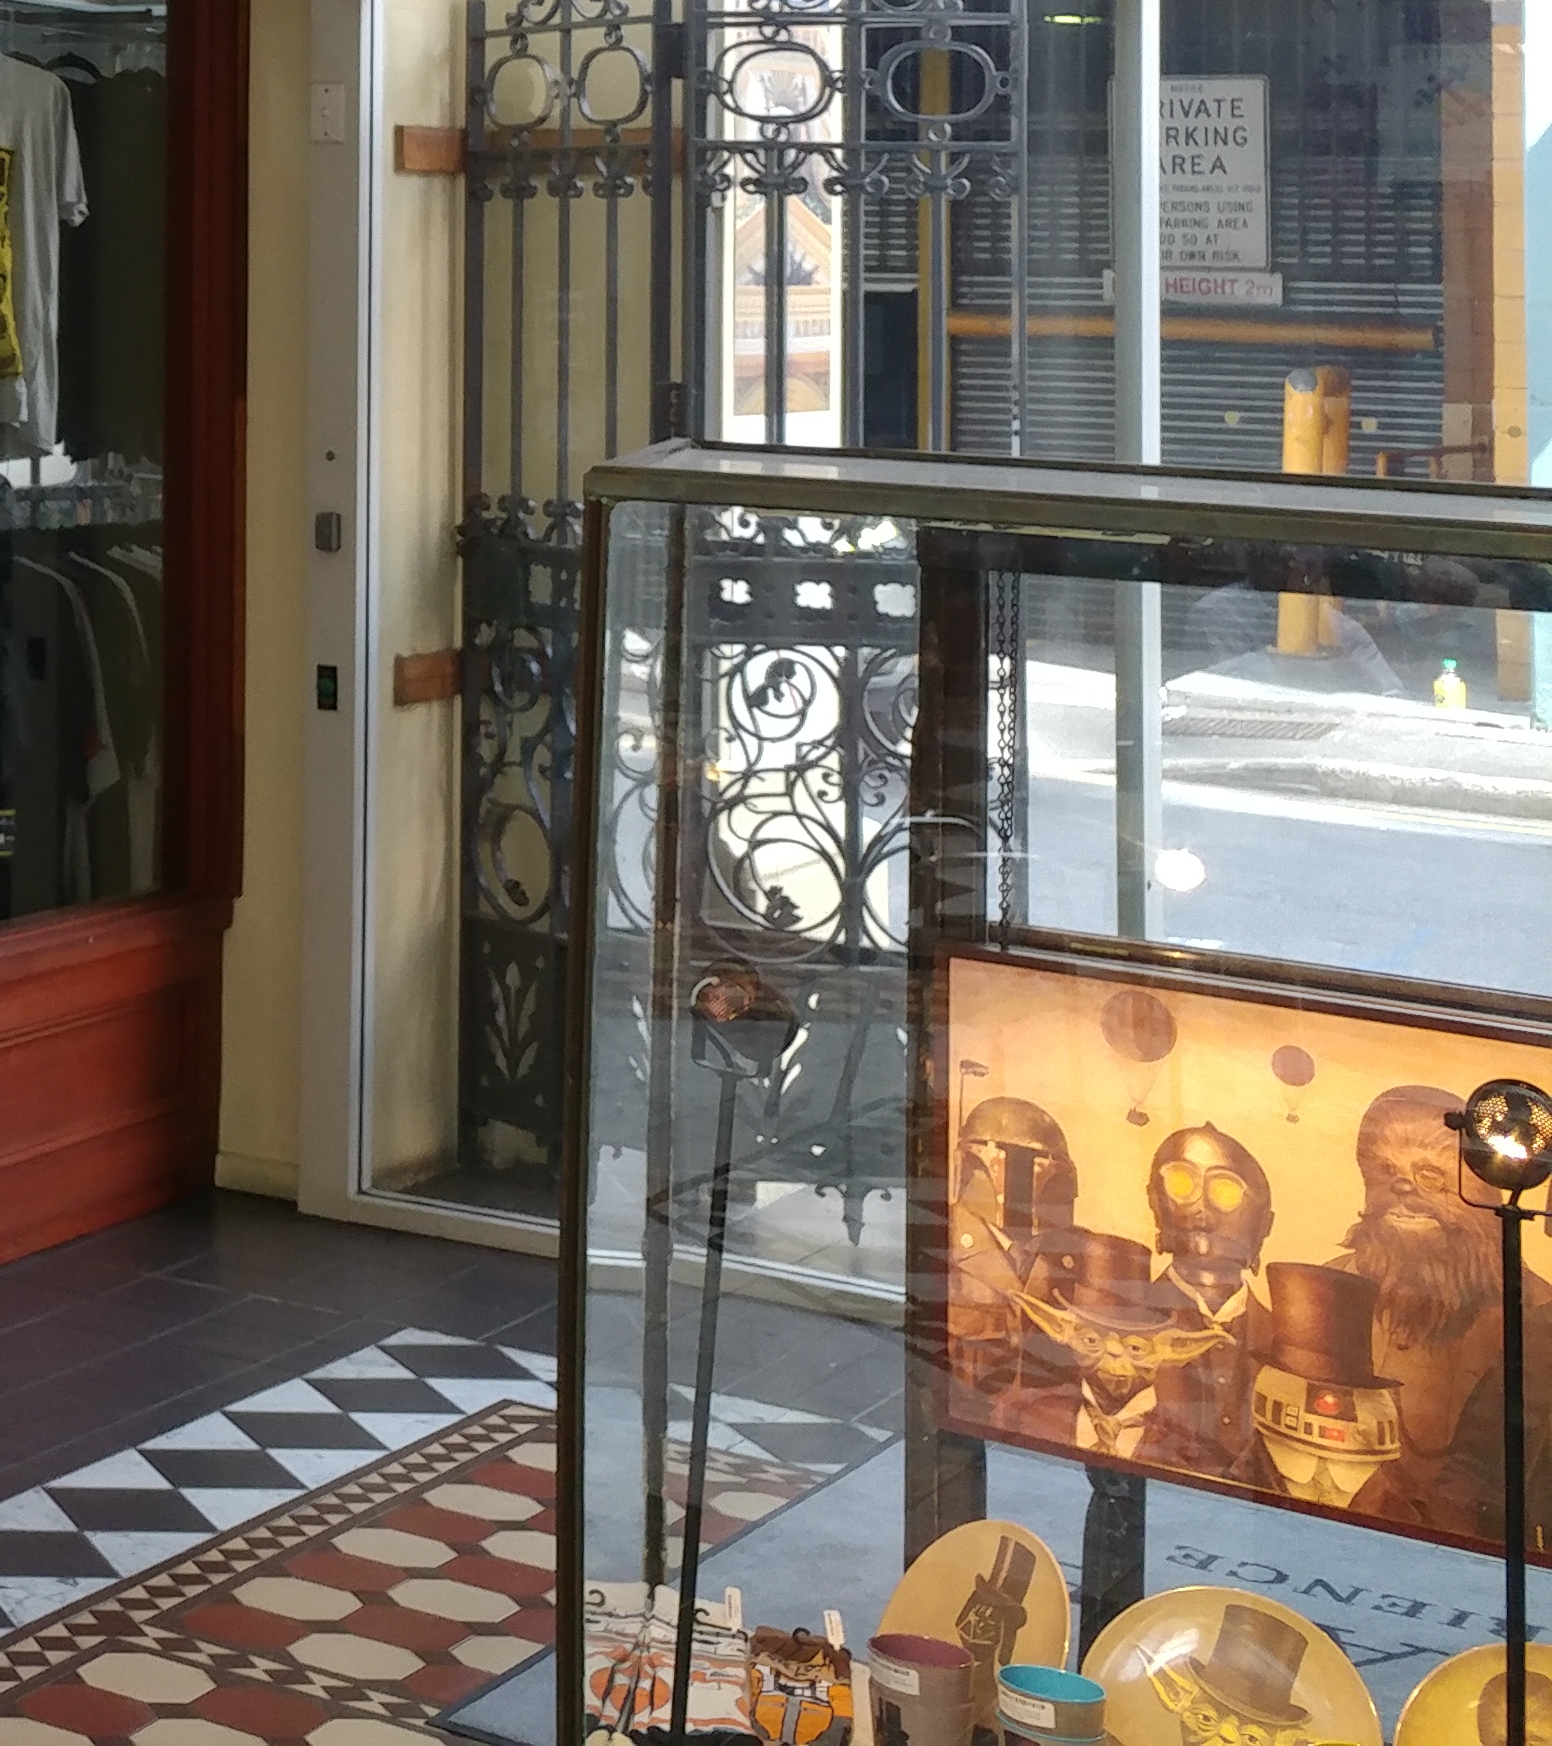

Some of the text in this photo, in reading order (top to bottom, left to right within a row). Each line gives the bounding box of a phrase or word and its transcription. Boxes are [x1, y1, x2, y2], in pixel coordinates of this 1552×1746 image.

[1160, 97, 1245, 119] IVATE
[1163, 125, 1249, 147] RKING
[1164, 276, 1274, 296] HEIGHT 2m
